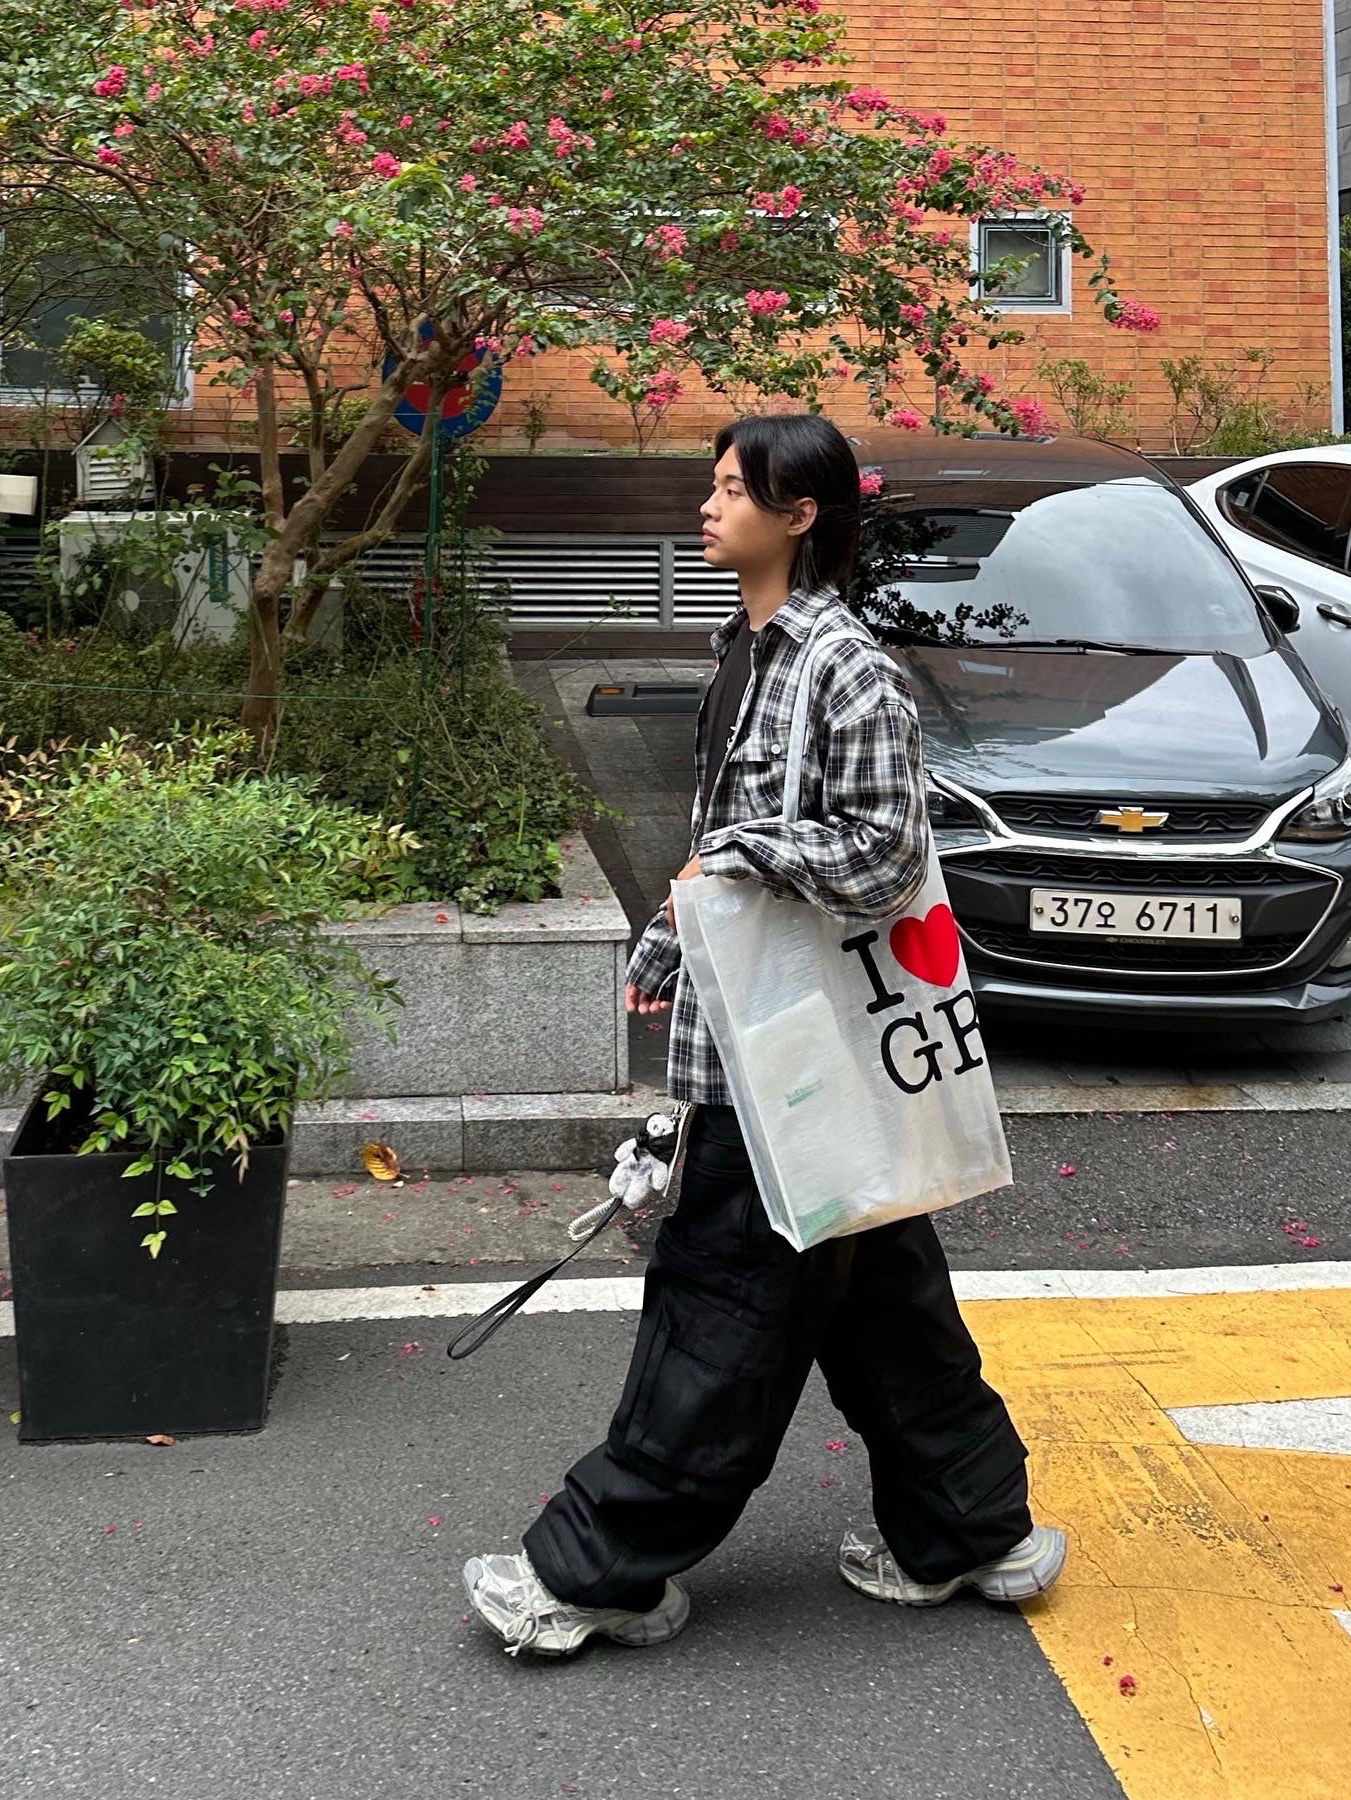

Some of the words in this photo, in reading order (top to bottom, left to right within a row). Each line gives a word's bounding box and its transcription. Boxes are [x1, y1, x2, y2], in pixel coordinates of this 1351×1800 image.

[1050, 896, 1116, 929] 37오
[1135, 901, 1218, 934] 6711
[841, 929, 905, 1015] I
